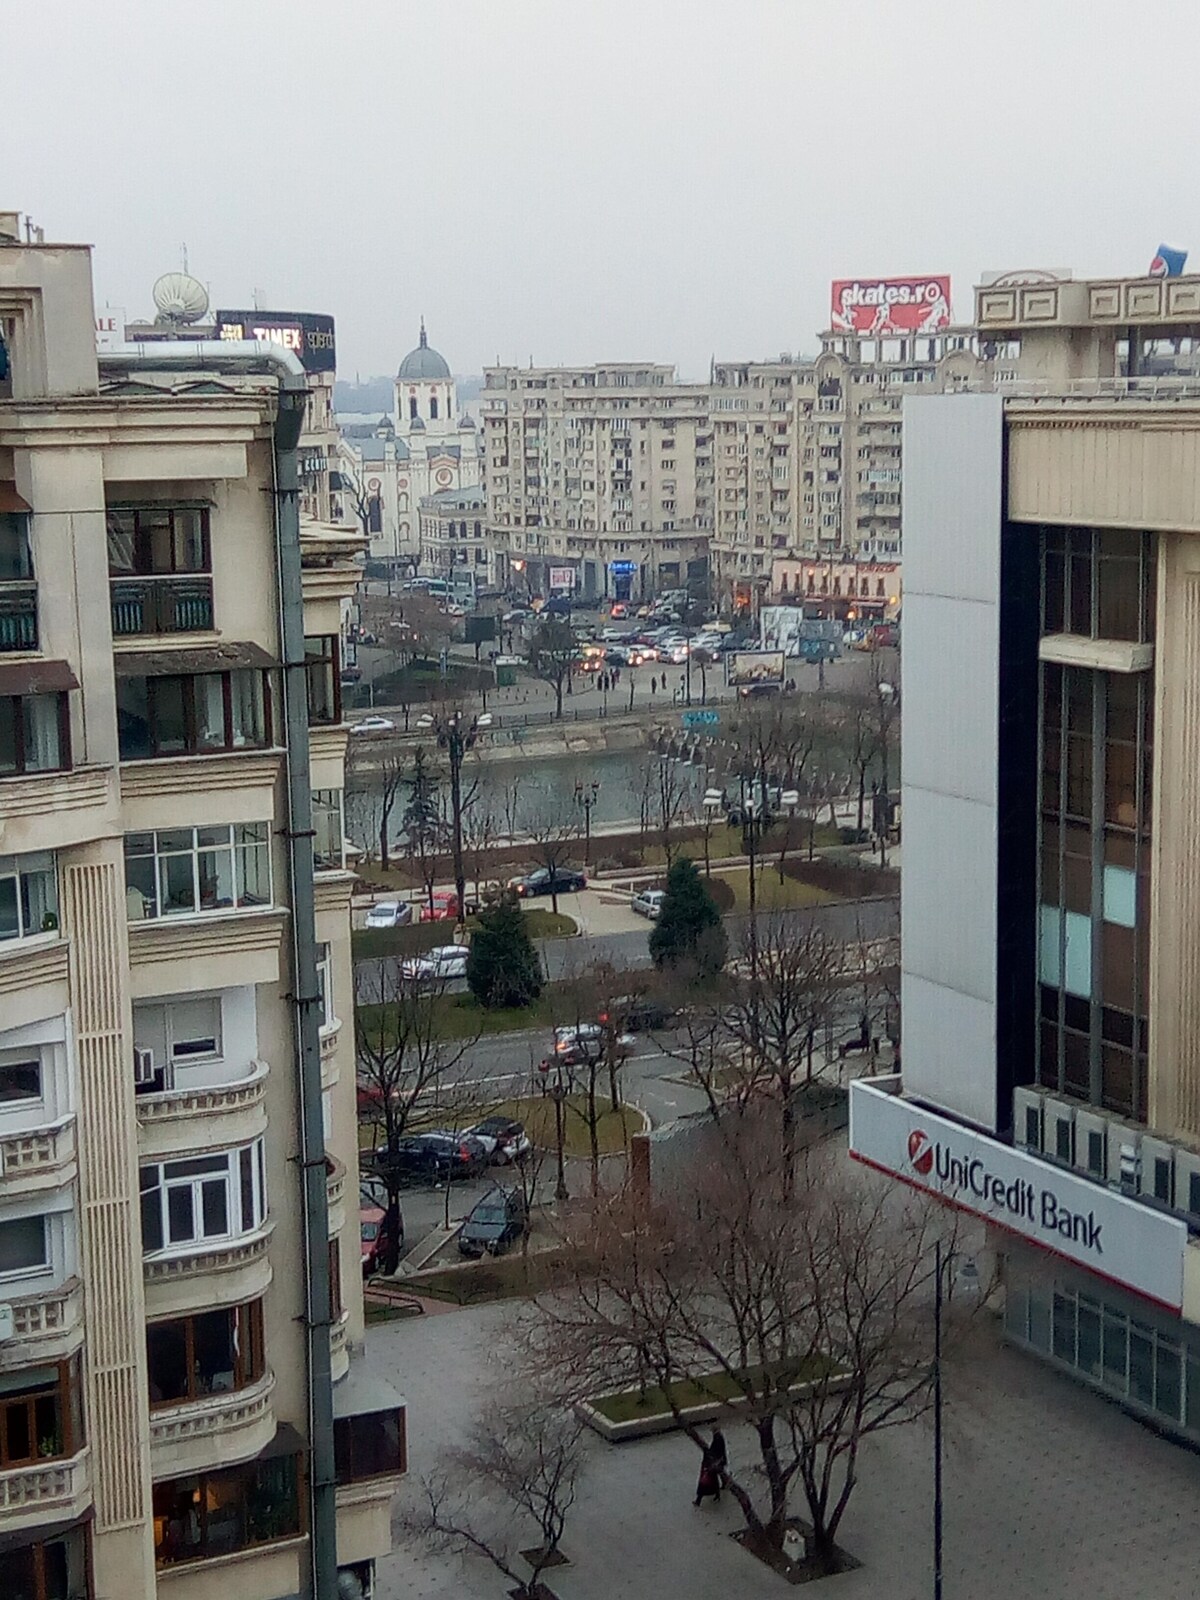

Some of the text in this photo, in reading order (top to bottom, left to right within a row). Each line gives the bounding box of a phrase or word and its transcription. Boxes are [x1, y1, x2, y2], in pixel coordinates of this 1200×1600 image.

[841, 281, 941, 306] skates.ro
[252, 327, 301, 349] TIMEX
[935, 1142, 1103, 1255] UniCredit Bank
